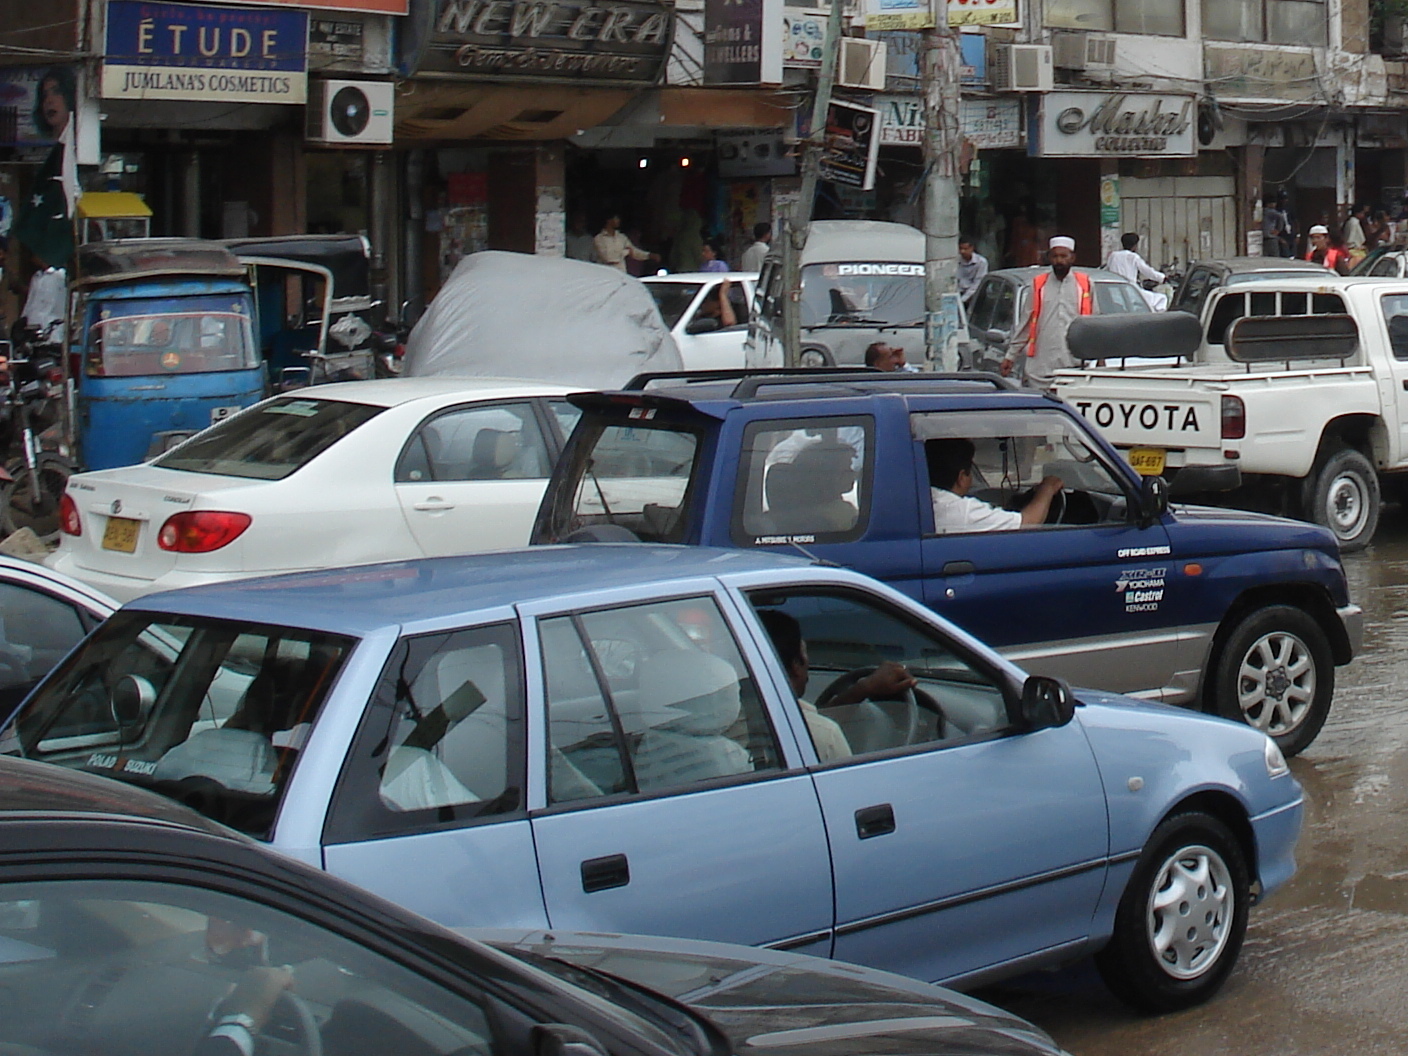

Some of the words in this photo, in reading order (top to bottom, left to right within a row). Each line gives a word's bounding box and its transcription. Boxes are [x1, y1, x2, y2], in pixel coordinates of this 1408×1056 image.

[567, 5, 671, 43] ERA
[137, 17, 278, 59] ÉTUDE
[122, 71, 205, 92] JUMLANA'S
[208, 73, 290, 94] COSMETICS
[838, 264, 926, 276] PIONEER
[1076, 401, 1200, 432] TOYOTA
[1129, 578, 1165, 589] YOKOHAMA
[1134, 589, 1164, 603] Castrol
[1125, 602, 1158, 613] KENWOOD
